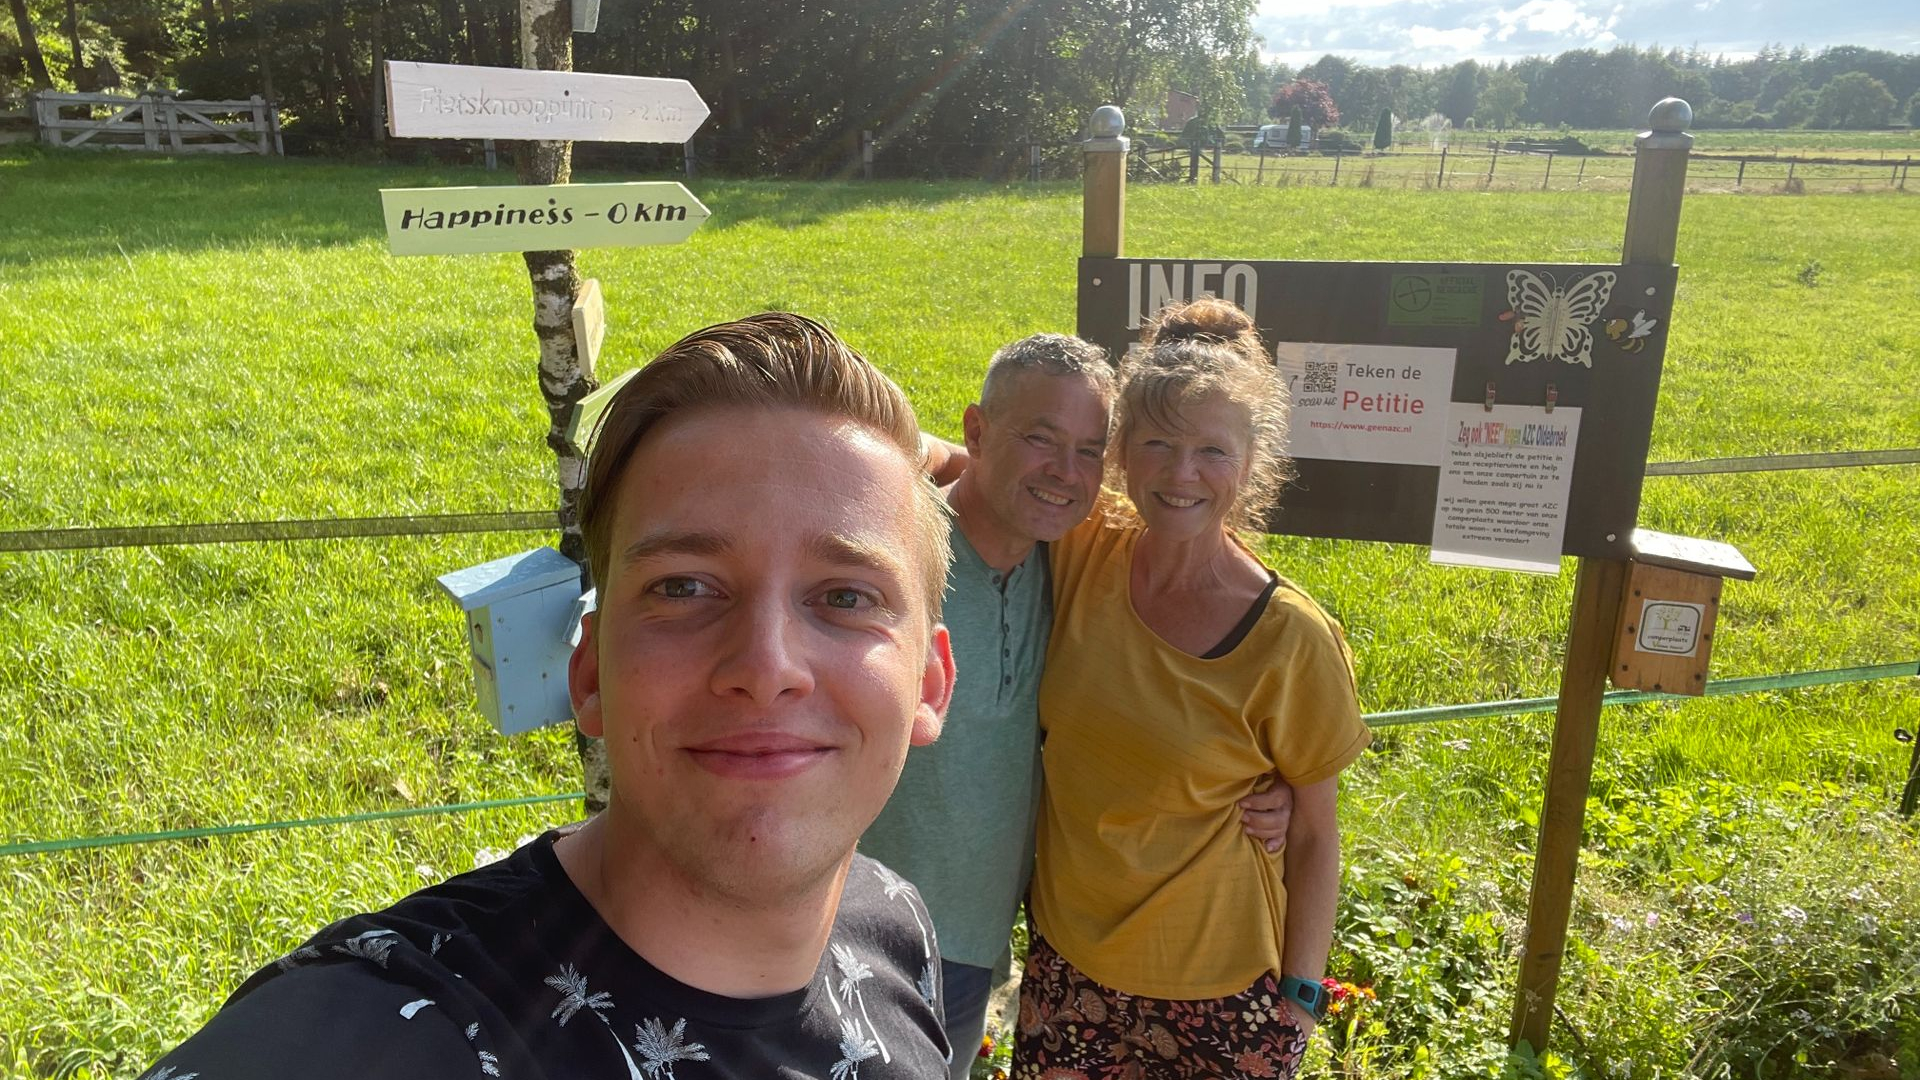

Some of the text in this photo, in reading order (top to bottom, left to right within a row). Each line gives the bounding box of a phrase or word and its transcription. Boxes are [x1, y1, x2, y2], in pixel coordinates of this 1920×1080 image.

[419, 87, 597, 124] Fietsknooppunt
[400, 202, 573, 229] Happiness
[634, 202, 687, 222] km
[1346, 363, 1422, 380] Teken de
[1343, 390, 1425, 415] Petitie
[1310, 420, 1412, 433] https://www.geenazc.nl
[1522, 424, 1536, 445] AZC
[1474, 451, 1513, 460] alsjeblieft
[1527, 453, 1553, 463] petitie
[1472, 461, 1527, 470] receptieruimte
[1541, 463, 1558, 472] help
[1496, 472, 1537, 481] campertuin
[1491, 480, 1509, 488] zoals
[1512, 481, 1522, 490] zij
[1542, 502, 1558, 510] AZC
[1447, 515, 1494, 524] camperplaats
[1503, 527, 1550, 538] leefomgeving
